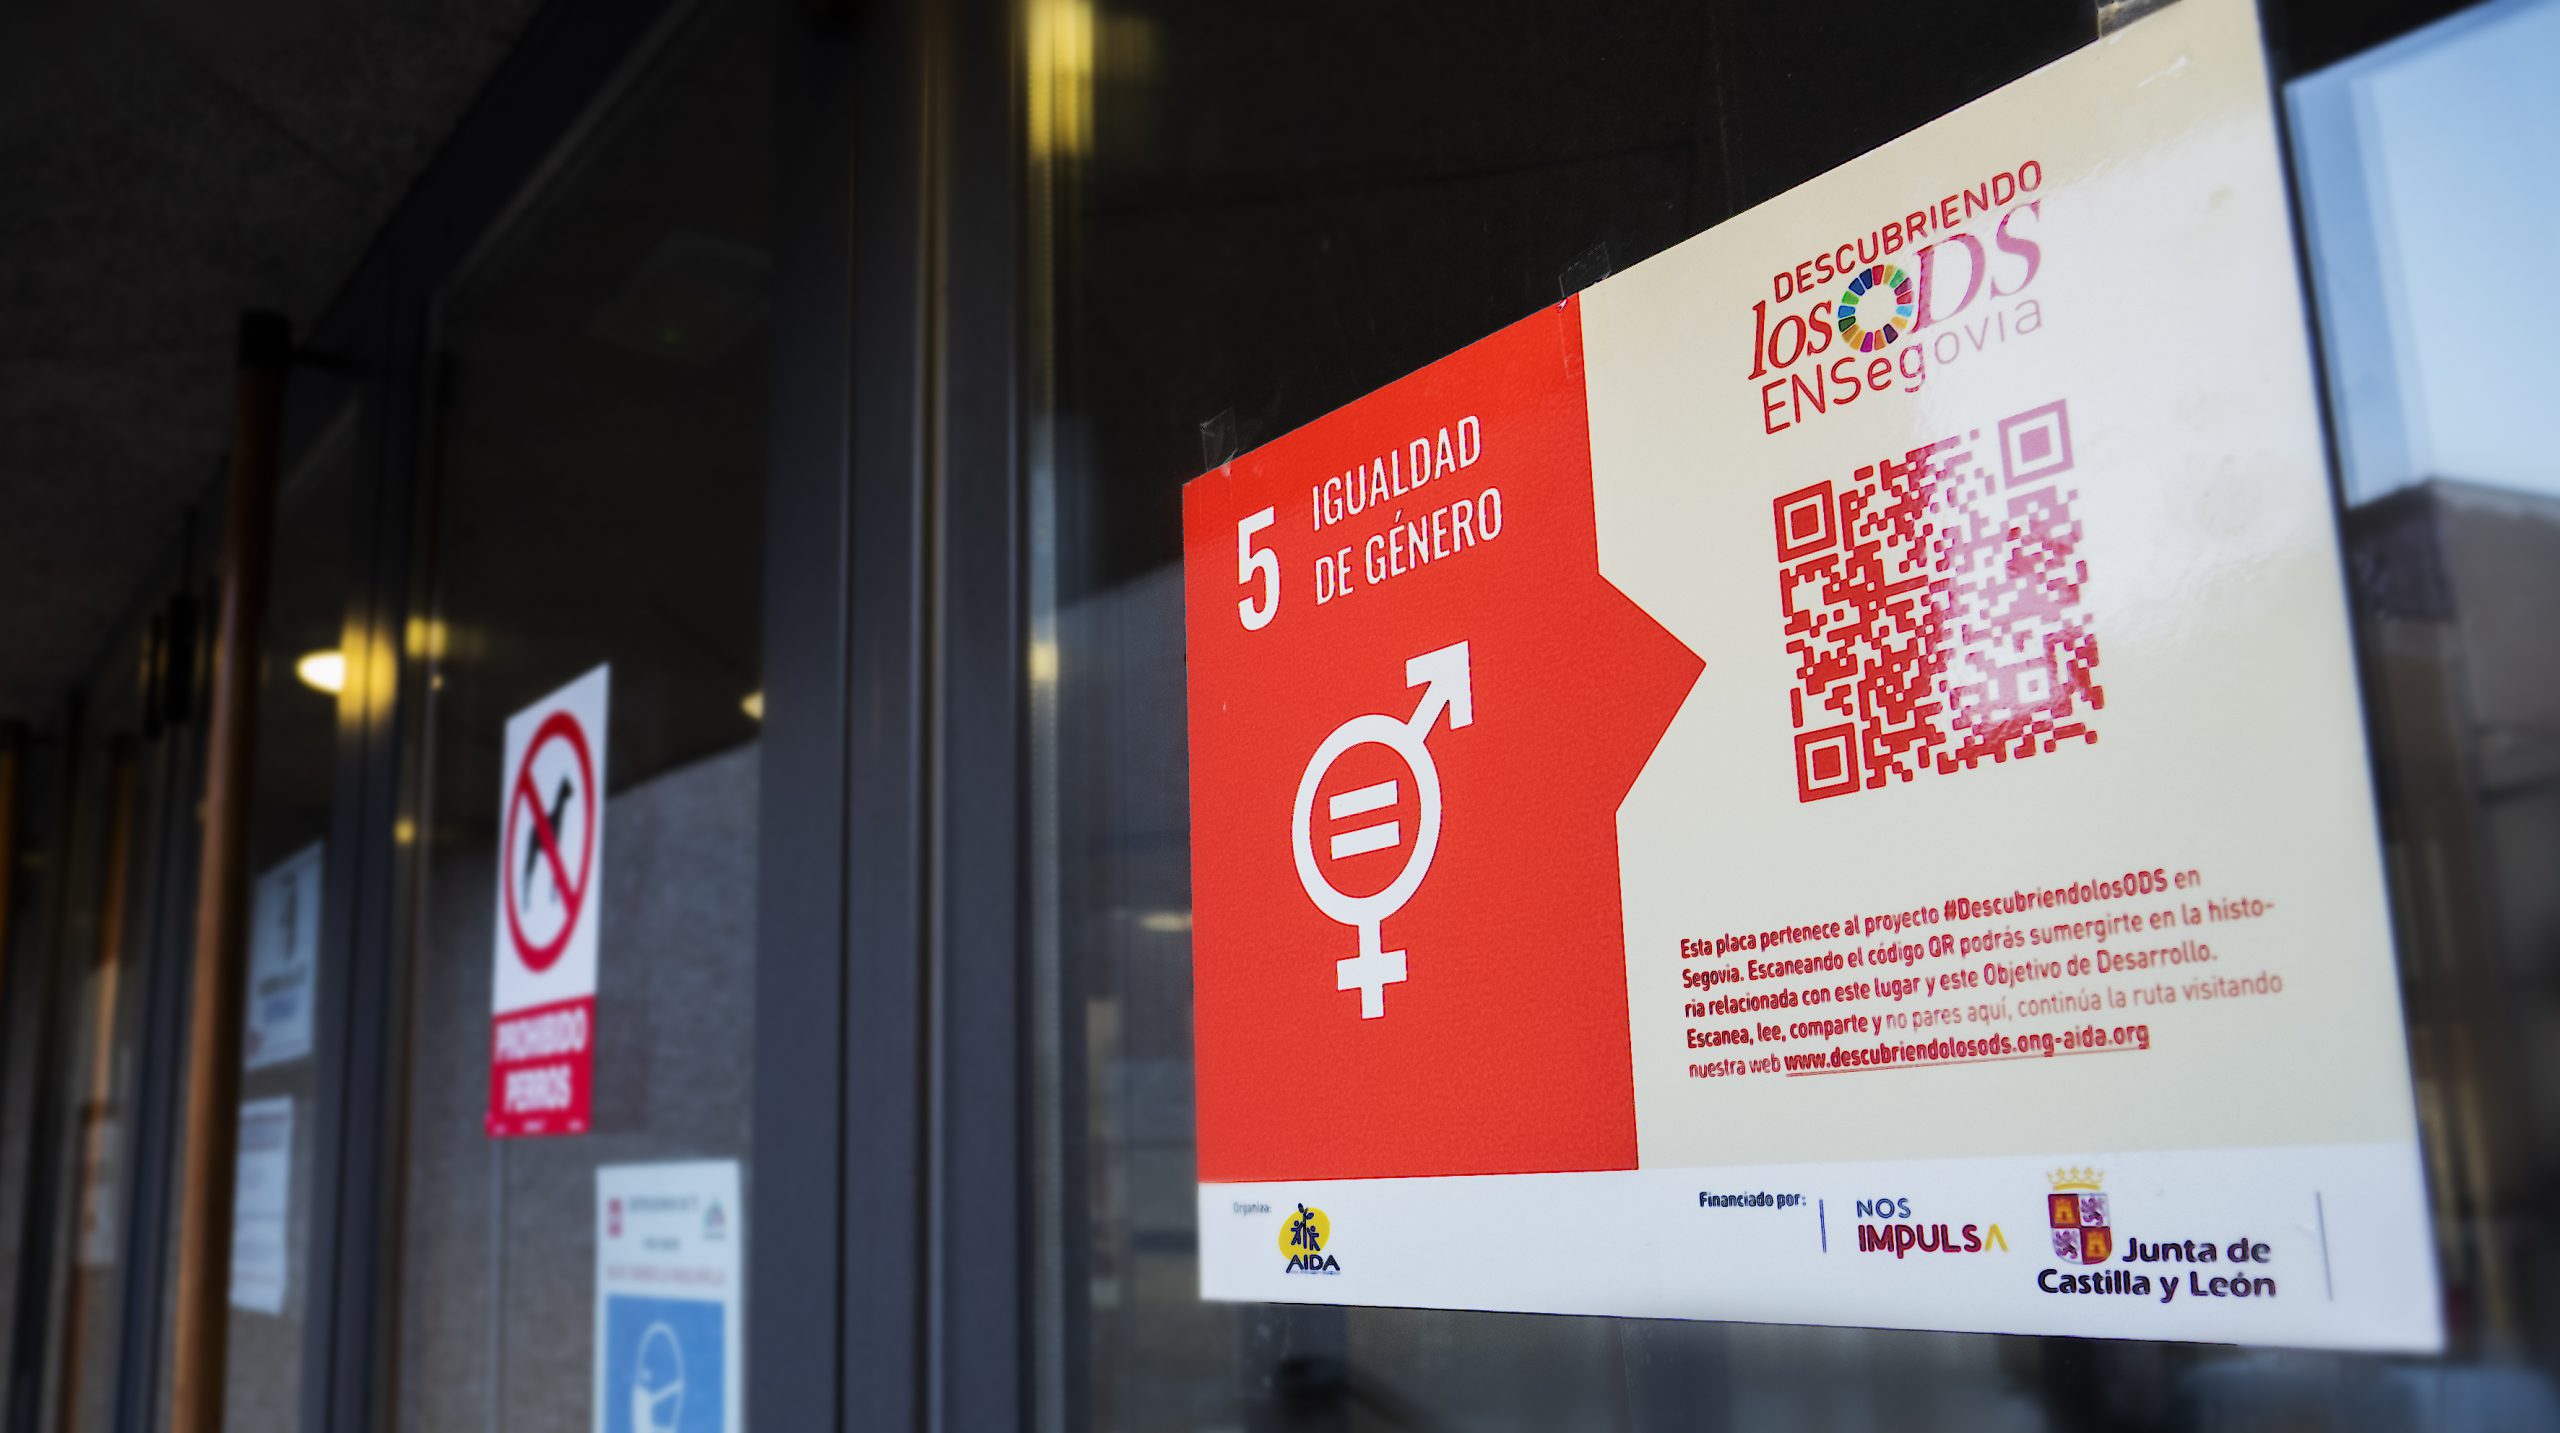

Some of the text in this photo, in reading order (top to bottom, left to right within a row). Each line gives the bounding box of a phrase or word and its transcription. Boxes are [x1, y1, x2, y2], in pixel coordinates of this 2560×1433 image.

[1773, 160, 2042, 303] DESCUBRIENDO
[1762, 299, 2042, 435] ENSegovia
[1311, 414, 1481, 531] IGUALDAD
[1237, 505, 1281, 631] 5
[1314, 487, 1503, 605] DE GÉNERO
[1680, 868, 2201, 959] Esta placa pertenece al proyecto #DescubriendolosODS en
[1682, 897, 2275, 992] Segovia. Escaneando el código QR podrás sumergirte en la histo-
[1684, 939, 2218, 1019] ria relacionada con este lugar y este Objetivo de Desarrollo.
[1686, 969, 2283, 1049] Escanea, lee, comparte y no pares aquí, continúa la ruta visitando
[1688, 1024, 2150, 1079] nuestra web www.descubriendolosods.ong-aida.org
[1699, 1191, 1807, 1210] Financiado por:
[1856, 1198, 1912, 1219] NOS
[1286, 1254, 1341, 1274] AIDA
[2037, 1268, 2277, 1304] Castilla y León
[2122, 1237, 2272, 1264] Junta de
